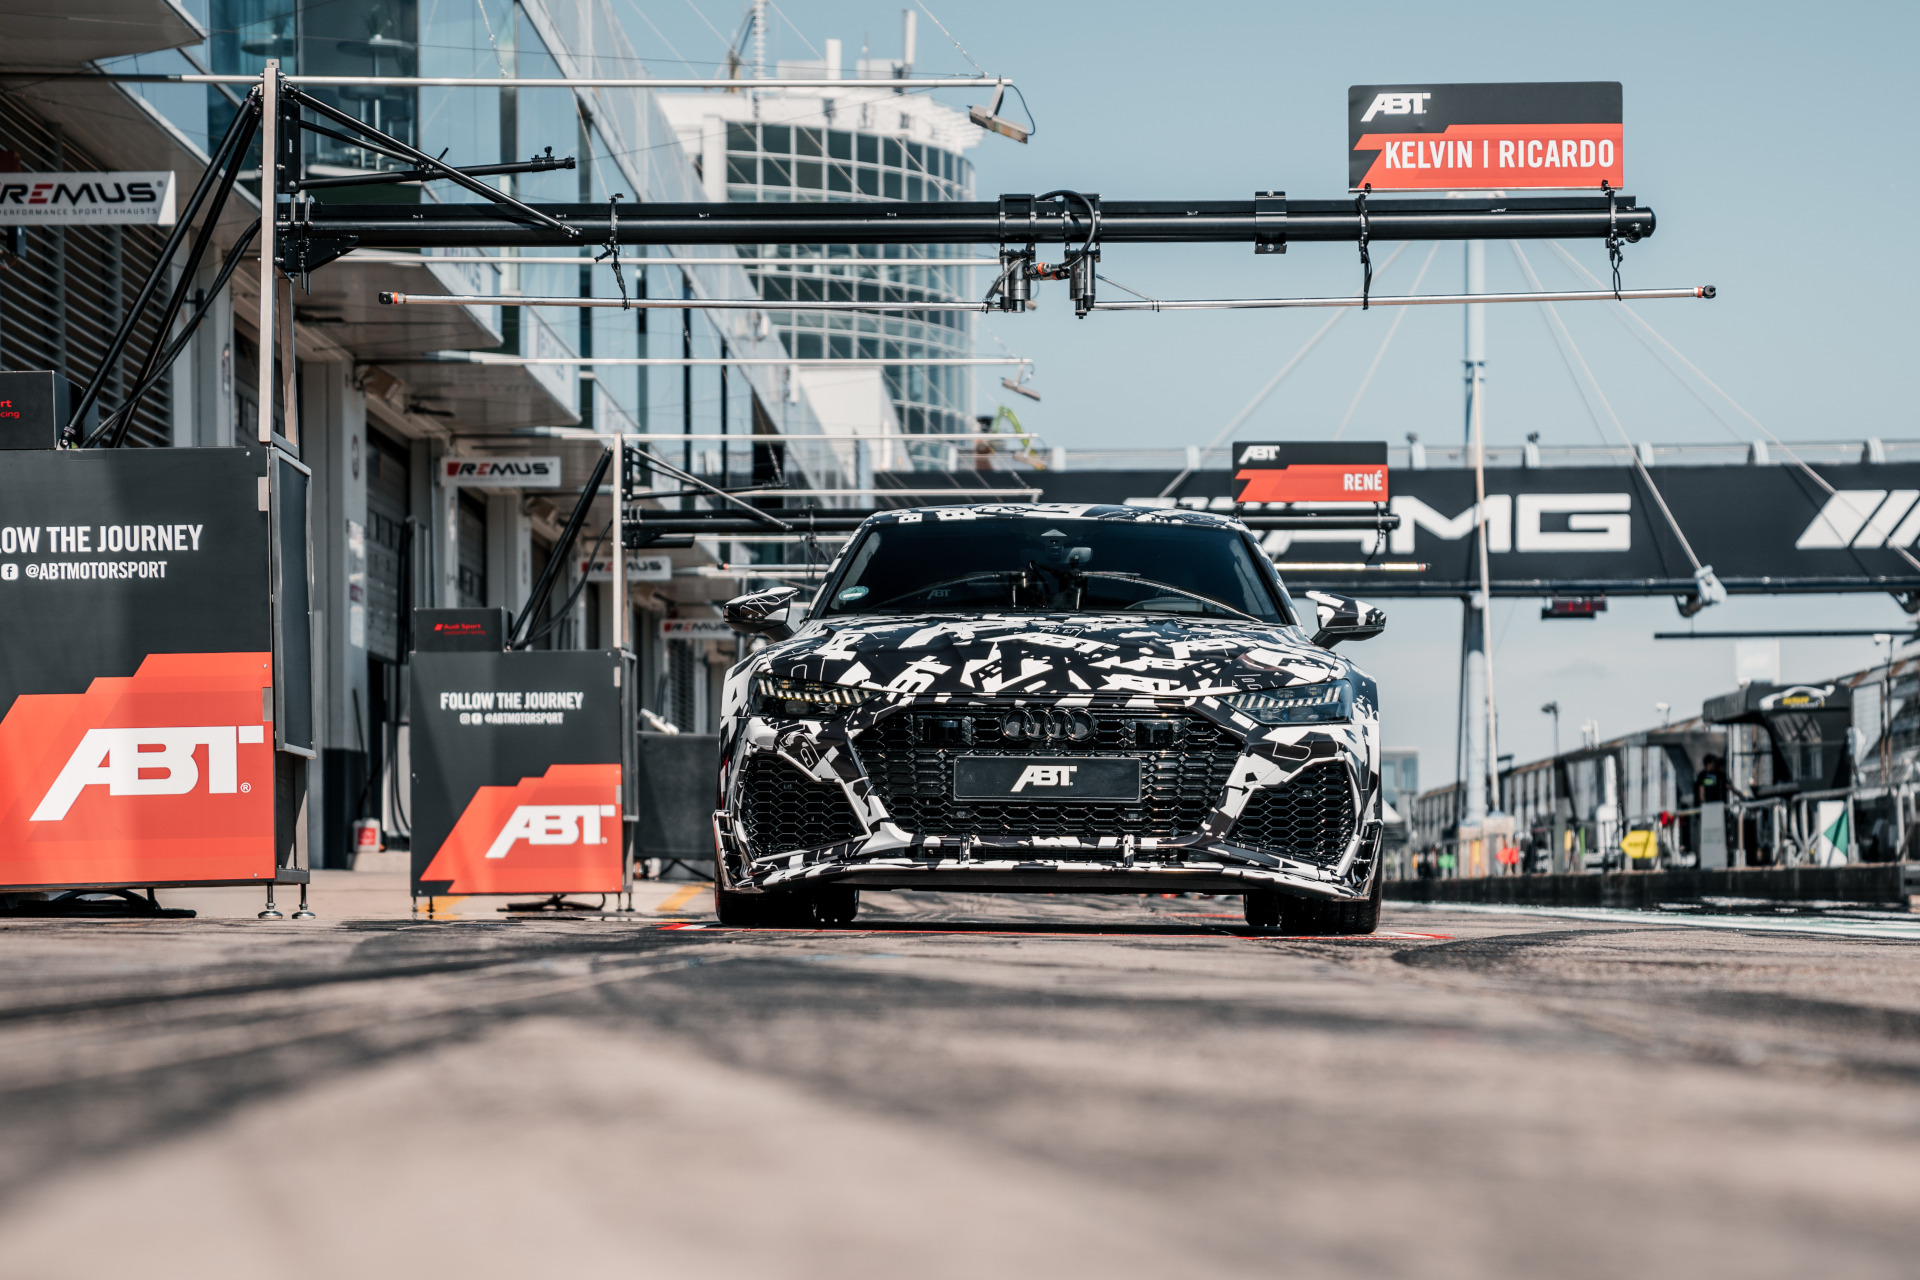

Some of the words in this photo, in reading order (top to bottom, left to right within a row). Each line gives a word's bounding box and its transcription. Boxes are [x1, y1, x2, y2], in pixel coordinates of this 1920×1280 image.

[1360, 93, 1431, 122] ABT
[1385, 141, 1473, 169] KELVIN
[1500, 139, 1614, 169] RICARDO
[0, 183, 157, 205] REMUS
[73, 208, 103, 216] SPORT
[108, 207, 157, 215] EXHAUSTS
[0, 411, 20, 419] cing
[1238, 445, 1280, 465] ABT
[459, 462, 549, 475] REMUS
[1343, 470, 1383, 491] RENÉ
[46, 526, 91, 552] THE
[97, 524, 204, 552] JOURNEY
[25, 561, 168, 580] @ABTMOTORSPORT
[440, 692, 494, 710] FOLLOW
[497, 692, 522, 709] THE
[524, 692, 584, 709] JOURNEY
[484, 712, 564, 724] @ABTMOTORSPORT
[29, 726, 264, 821] ABT
[1010, 765, 1078, 792] ABT
[485, 805, 616, 859] ABT
